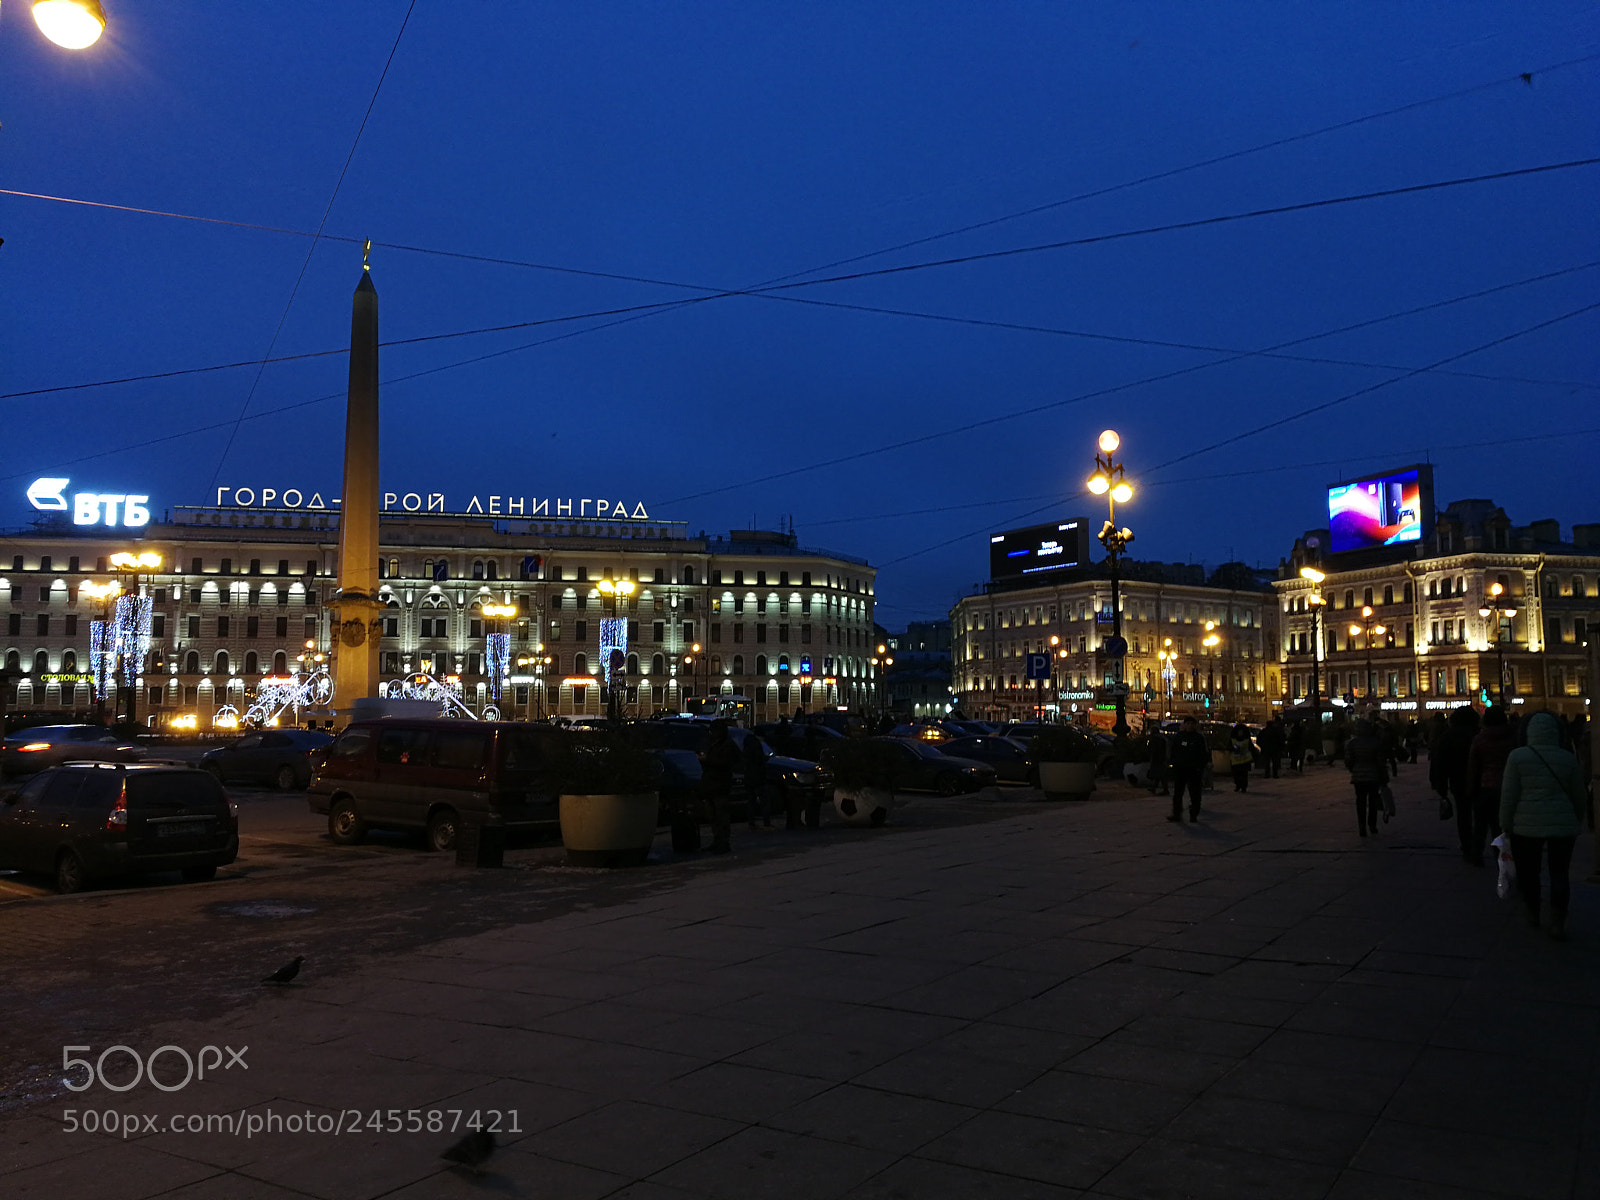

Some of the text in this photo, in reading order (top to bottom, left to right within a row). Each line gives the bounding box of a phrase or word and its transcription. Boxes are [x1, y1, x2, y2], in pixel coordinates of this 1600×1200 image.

[73, 493, 150, 527] ВТБ
[217, 486, 649, 520] ГОРОД-РОЙ ЛЕНИНГРАД
[195, 513, 340, 528] ГОСТИНИЦ
[1032, 655, 1047, 677] P
